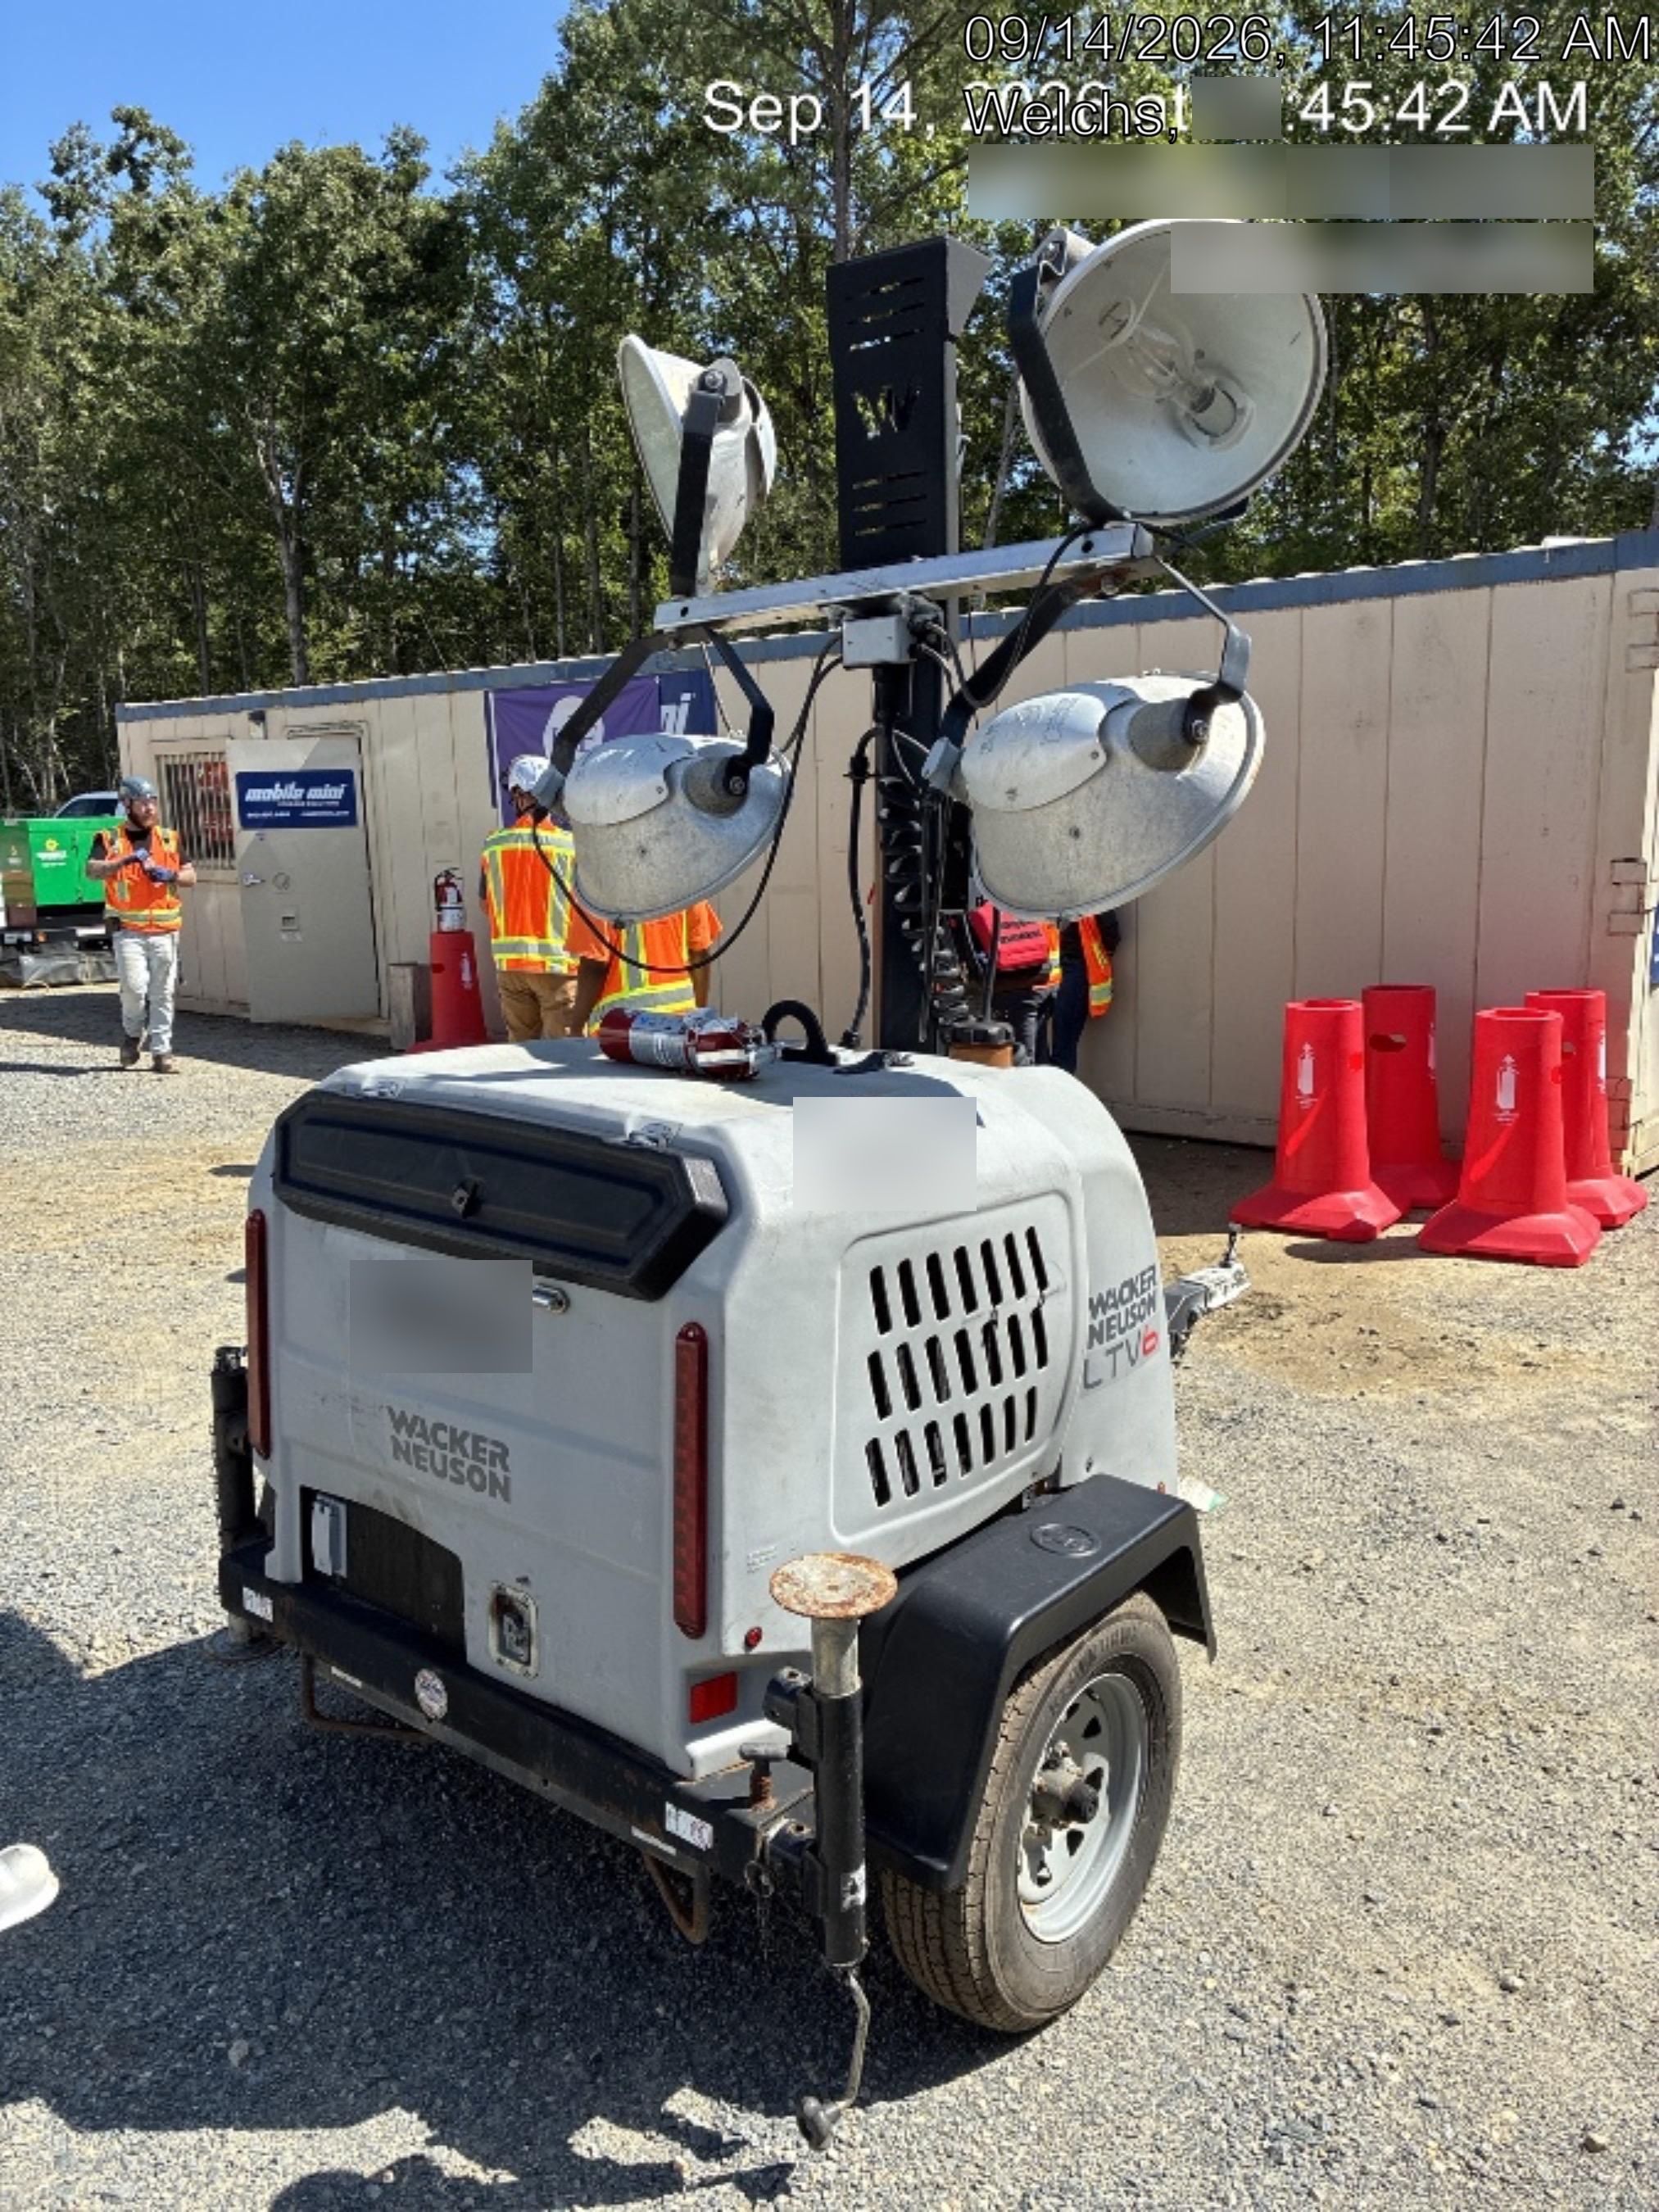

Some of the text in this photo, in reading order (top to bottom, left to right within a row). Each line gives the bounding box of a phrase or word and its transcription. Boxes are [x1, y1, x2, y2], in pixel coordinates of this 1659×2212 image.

[244, 781, 346, 802] mobile mini
[1088, 1264, 1156, 1321] WACKER
[1088, 1292, 1156, 1350] NEUSON
[385, 1405, 510, 1473] WACKER
[390, 1435, 512, 1505] NEUSON
